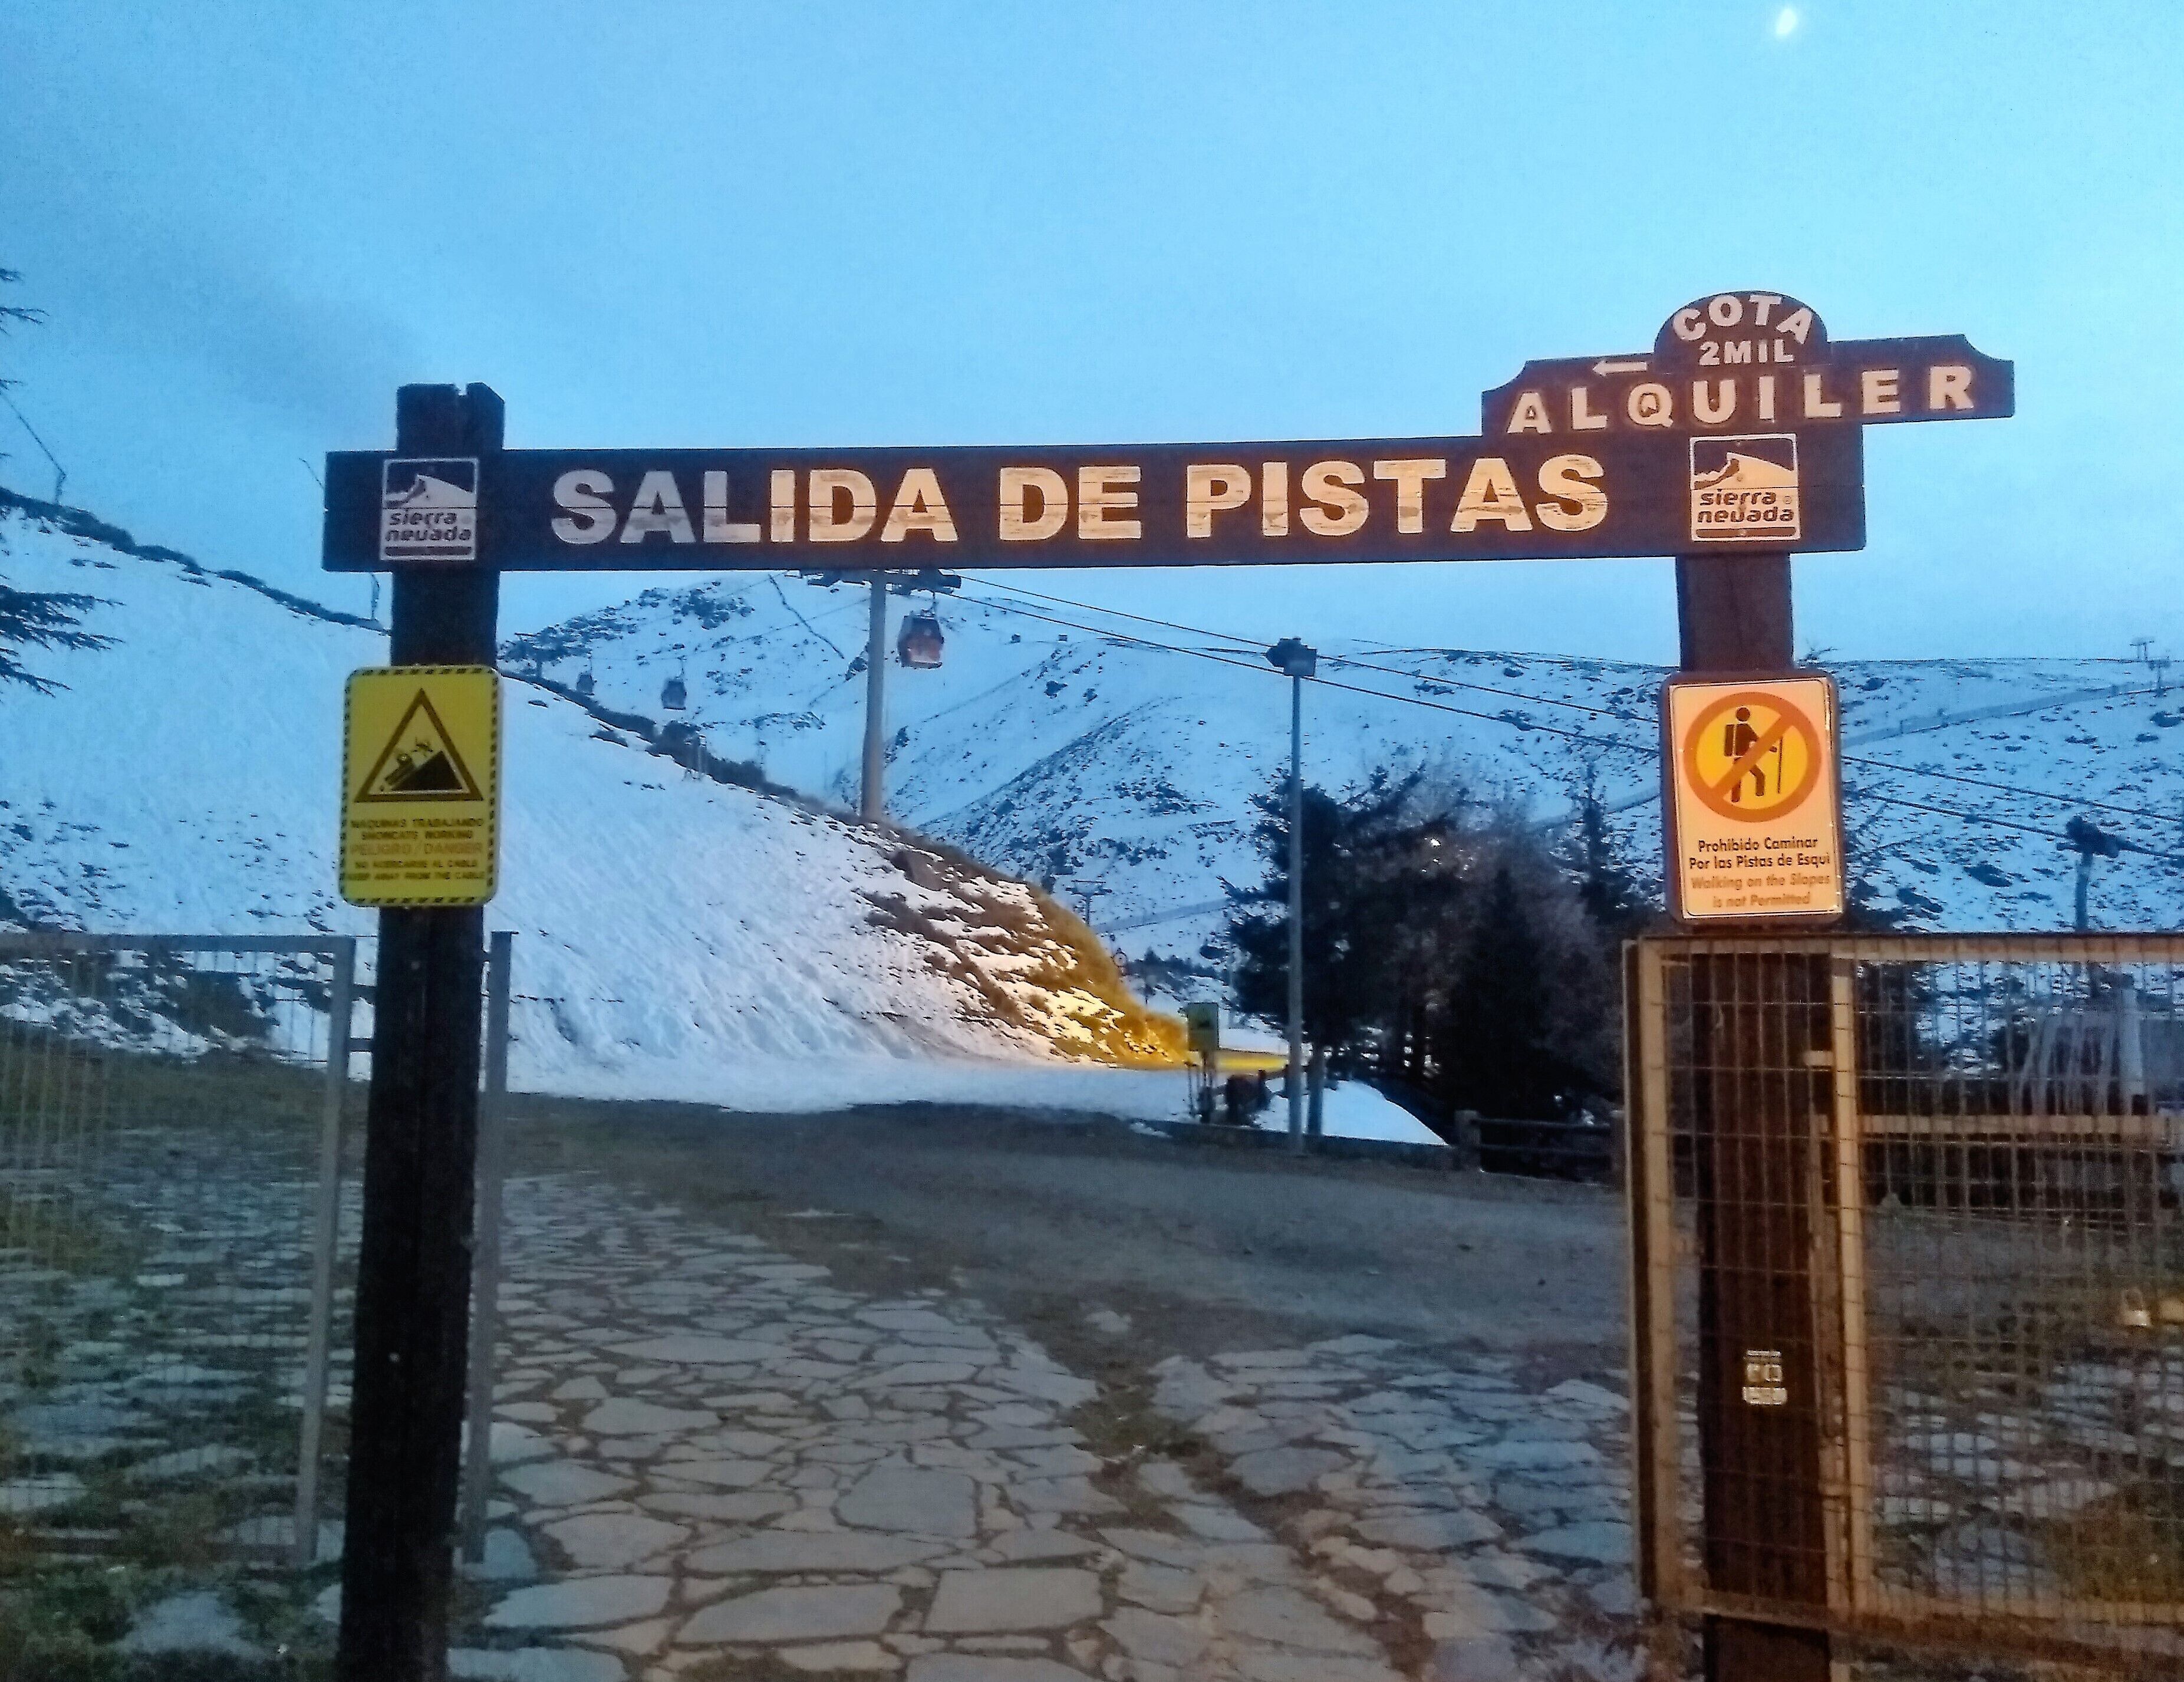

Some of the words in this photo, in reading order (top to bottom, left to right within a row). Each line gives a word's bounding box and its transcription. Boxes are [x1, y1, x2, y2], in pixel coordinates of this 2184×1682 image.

[1673, 294, 1814, 344] COTA
[1698, 339, 1794, 366] 2MIL
[1507, 365, 1974, 435] ALQUILER
[551, 467, 959, 545] SALIDA
[999, 465, 1142, 541] DE
[1186, 453, 1609, 538] PISTAS
[1699, 488, 1776, 506] sierra
[390, 509, 457, 525] sierra
[1698, 837, 1760, 852] Prohibido
[1764, 836, 1819, 850] Caminar
[1689, 857, 1710, 869] Por
[1714, 855, 1732, 868] las
[1736, 855, 1773, 867] Pistas
[1777, 853, 1793, 866] de
[1747, 878, 1762, 887] on
[1766, 874, 1785, 886] the
